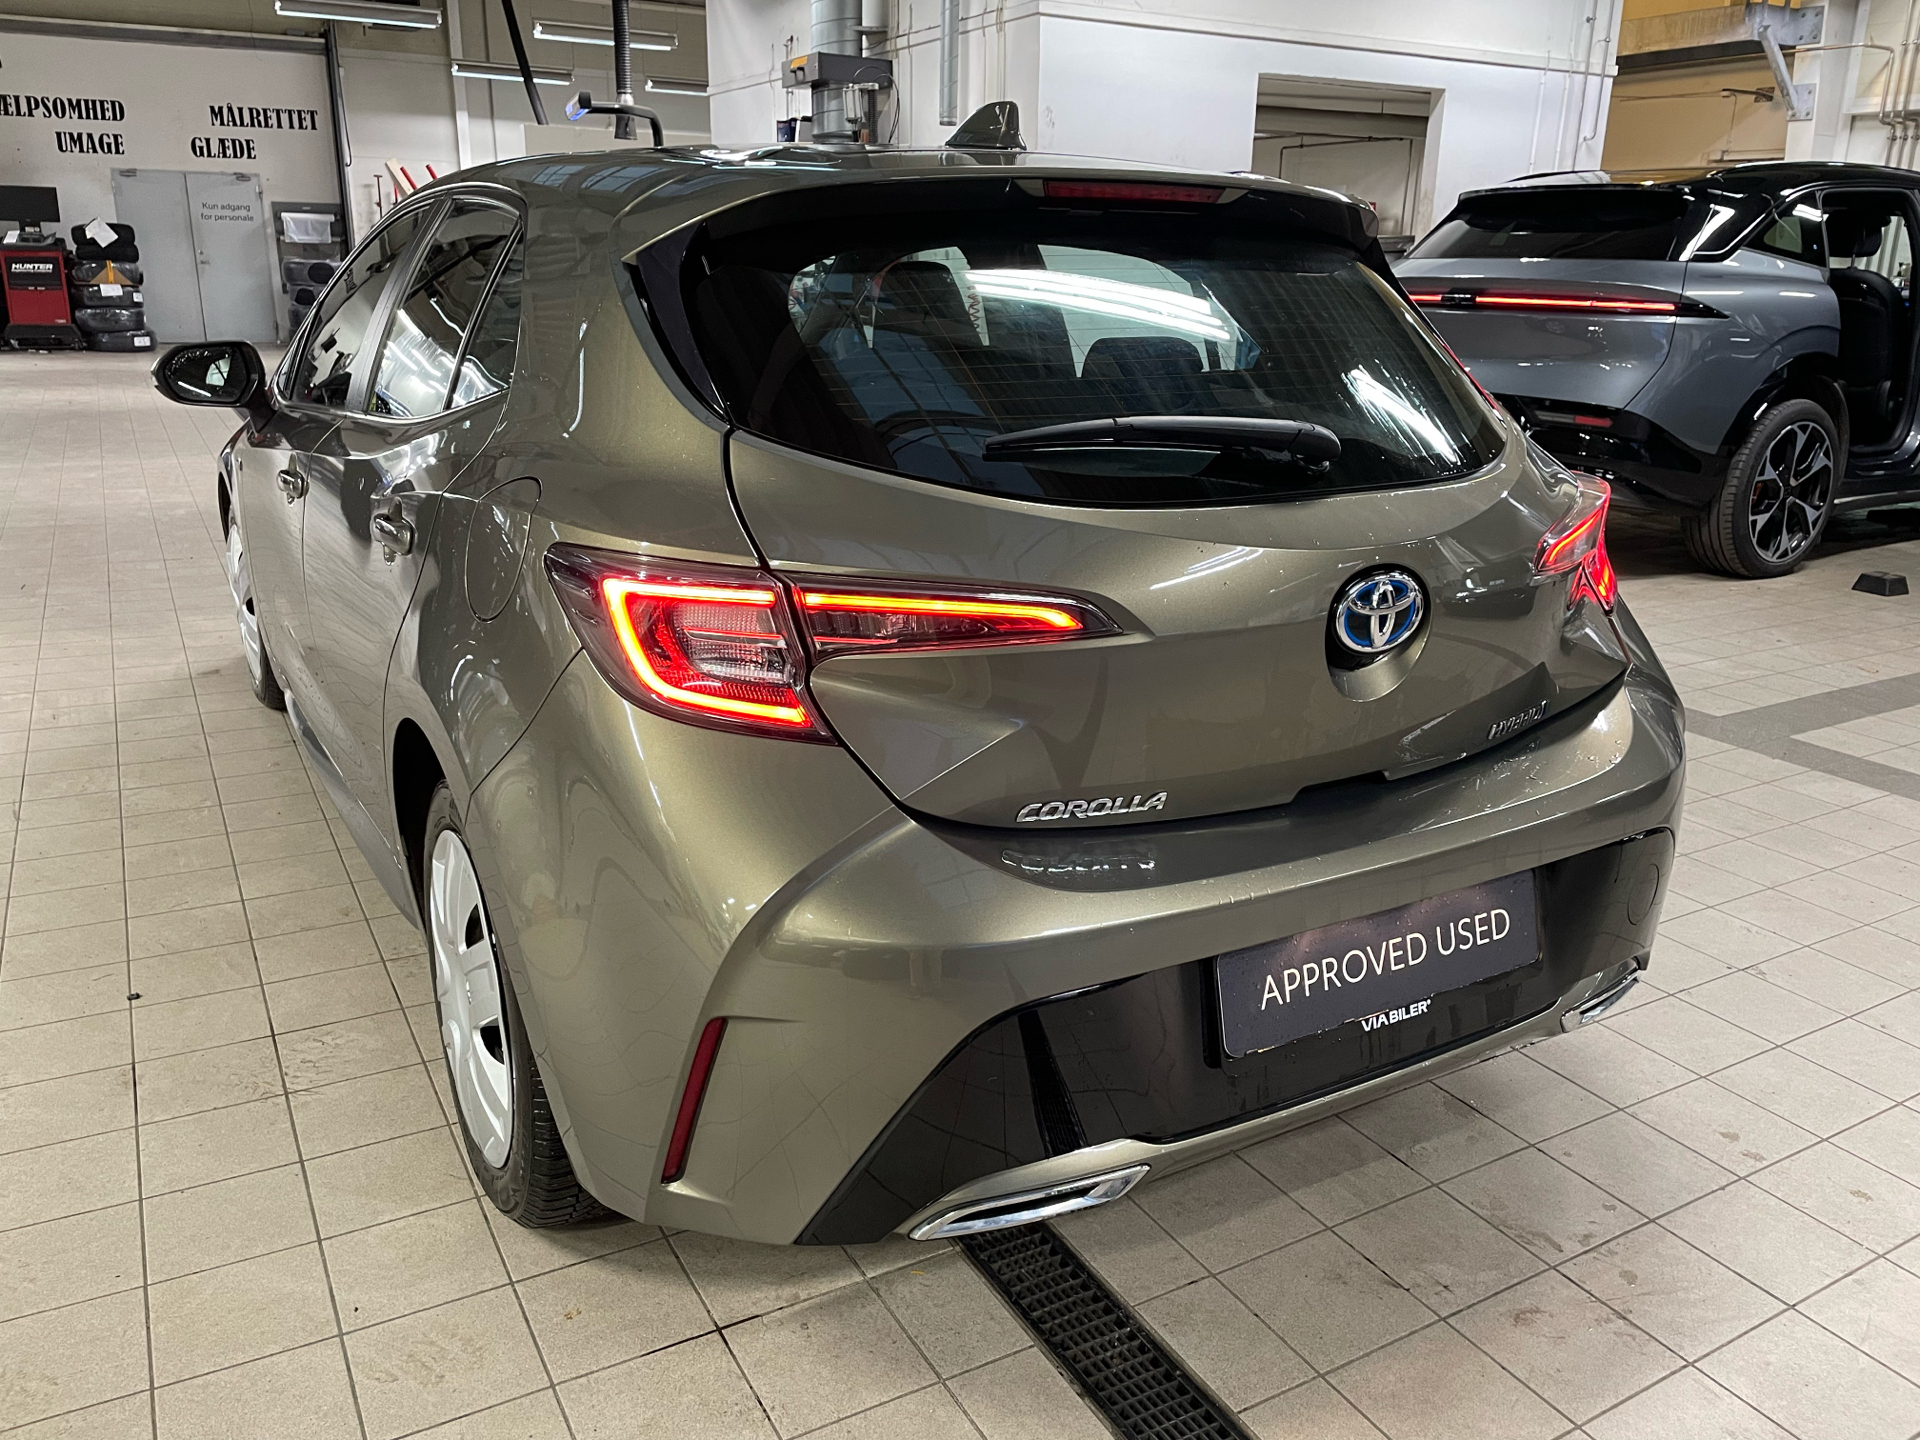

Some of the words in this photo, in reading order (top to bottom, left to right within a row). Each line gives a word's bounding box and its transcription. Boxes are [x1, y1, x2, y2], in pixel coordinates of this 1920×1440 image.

[209, 102, 318, 131] MÅLRETTET
[55, 131, 125, 155] UMAGE
[190, 136, 257, 160] GLÆDE
[200, 212, 213, 220] for
[214, 213, 254, 222] personale
[202, 202, 219, 210] Kun
[220, 203, 251, 212] adgang
[11, 263, 53, 271] HUNTER
[1016, 790, 1168, 823] COROLLA
[1261, 932, 1427, 1010] APPROVED
[1436, 908, 1511, 955] USED
